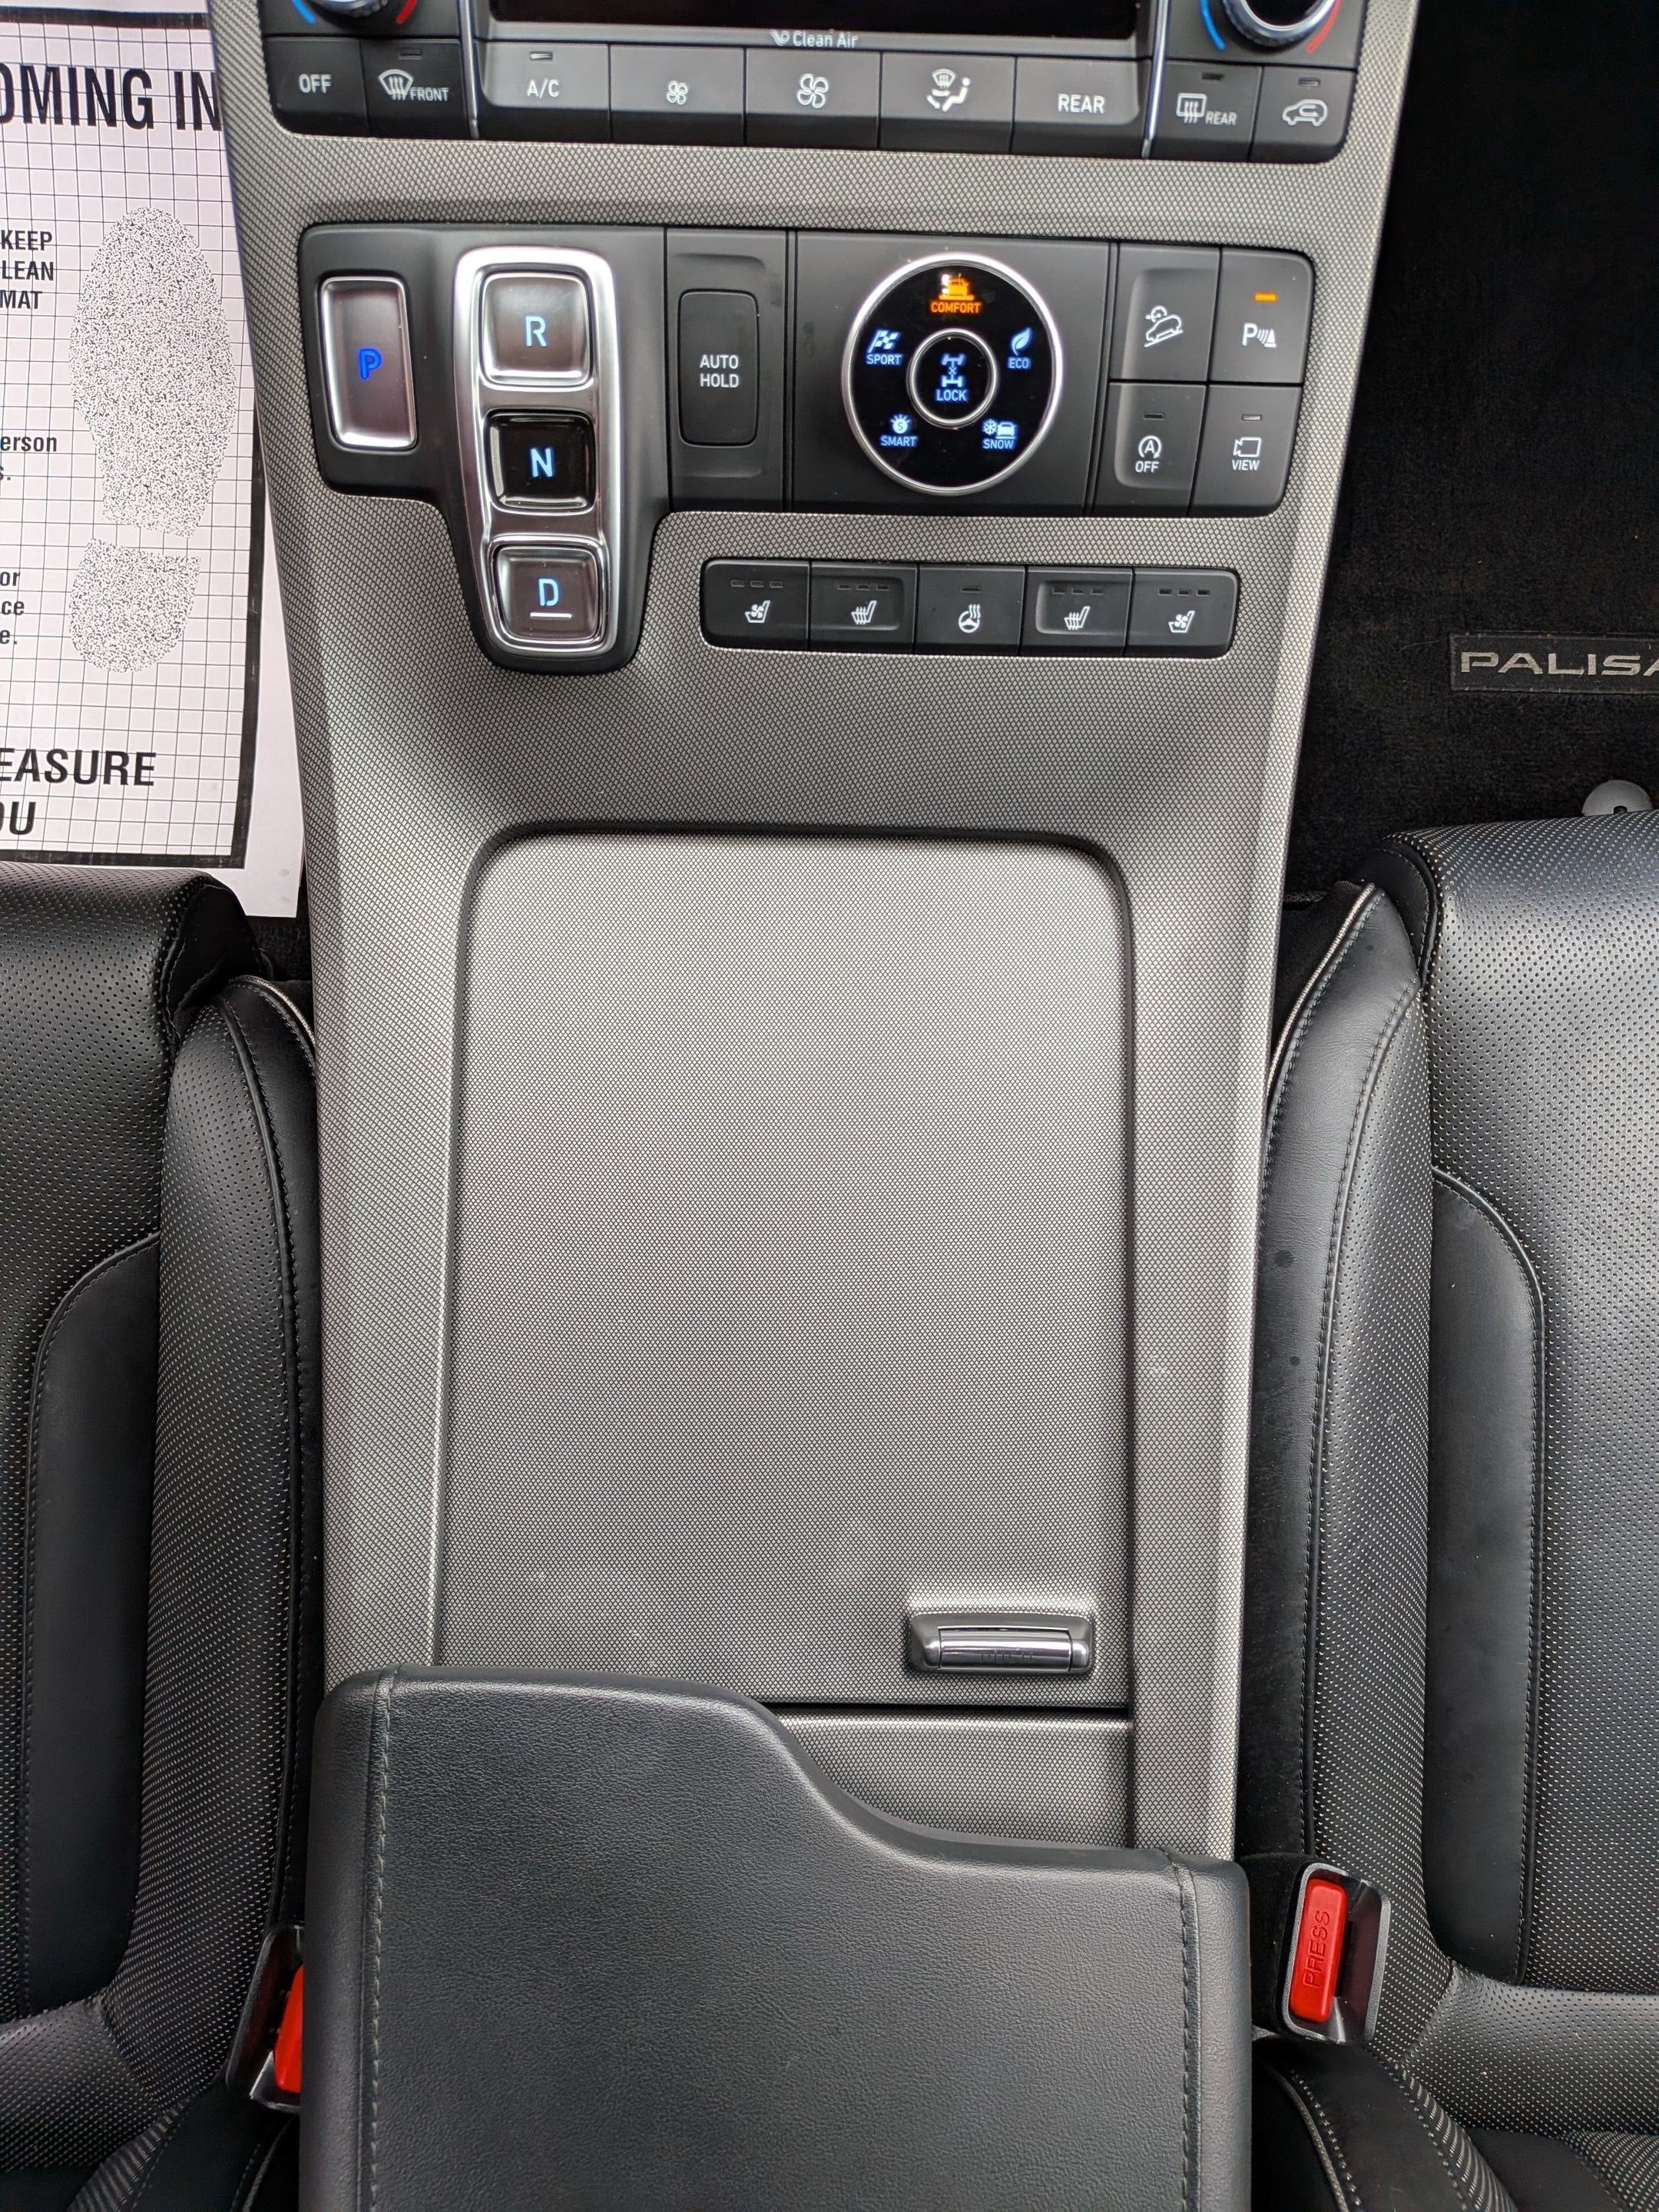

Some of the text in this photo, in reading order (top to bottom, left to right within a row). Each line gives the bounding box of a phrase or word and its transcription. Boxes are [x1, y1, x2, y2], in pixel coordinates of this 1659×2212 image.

[793, 31, 858, 48] Clean Air
[299, 74, 332, 94] OFF
[526, 78, 559, 98] A/C
[174, 70, 222, 131] IN
[409, 87, 449, 101] FRONT
[1058, 93, 1105, 114] REAR
[1205, 111, 1237, 125] REAR
[1, 229, 52, 250] KEEP
[2, 260, 54, 281] LEAN
[0, 289, 43, 309] MAT
[930, 301, 982, 314] COMFORT
[524, 315, 548, 347] R
[1241, 323, 1257, 346] P
[357, 348, 382, 379] P
[699, 354, 739, 369] AUTO
[866, 353, 902, 366] SPORT
[1008, 358, 1029, 369] ECO
[700, 373, 739, 388] HOLD
[935, 389, 967, 401] LOCK
[0, 435, 58, 452] erson
[880, 435, 917, 447] SMART
[982, 438, 1015, 449] SNOW
[530, 447, 554, 478] N
[1135, 461, 1159, 472] OFF
[1231, 459, 1260, 471] VIEW
[0, 571, 21, 587] or
[538, 578, 560, 608] D
[1, 600, 25, 616] ce
[0, 747, 157, 786] EASURE
[0, 800, 37, 835] U
[981, 1651, 1034, 1665] PUSH
[1302, 1910, 1330, 1989] PRESS
